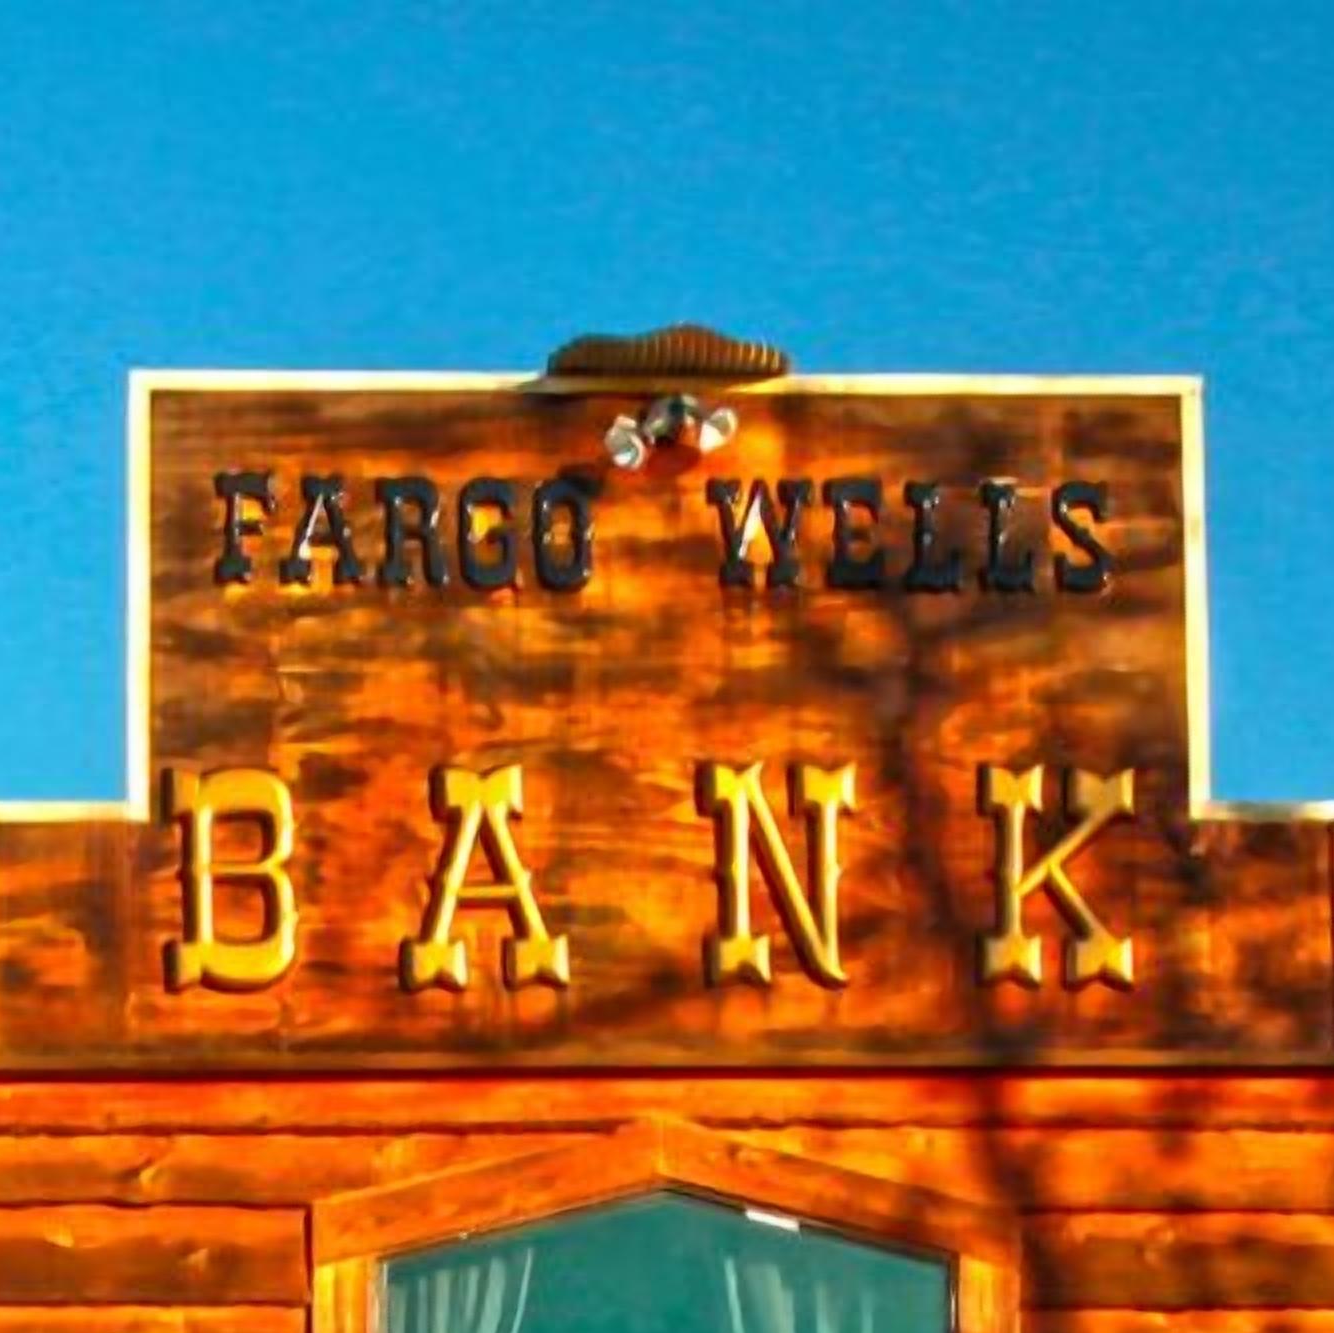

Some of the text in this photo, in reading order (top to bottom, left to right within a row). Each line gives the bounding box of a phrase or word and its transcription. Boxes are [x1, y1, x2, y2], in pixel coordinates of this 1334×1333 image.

[214, 471, 1115, 594] FARGO WELLS
[162, 760, 1134, 993] BANK
